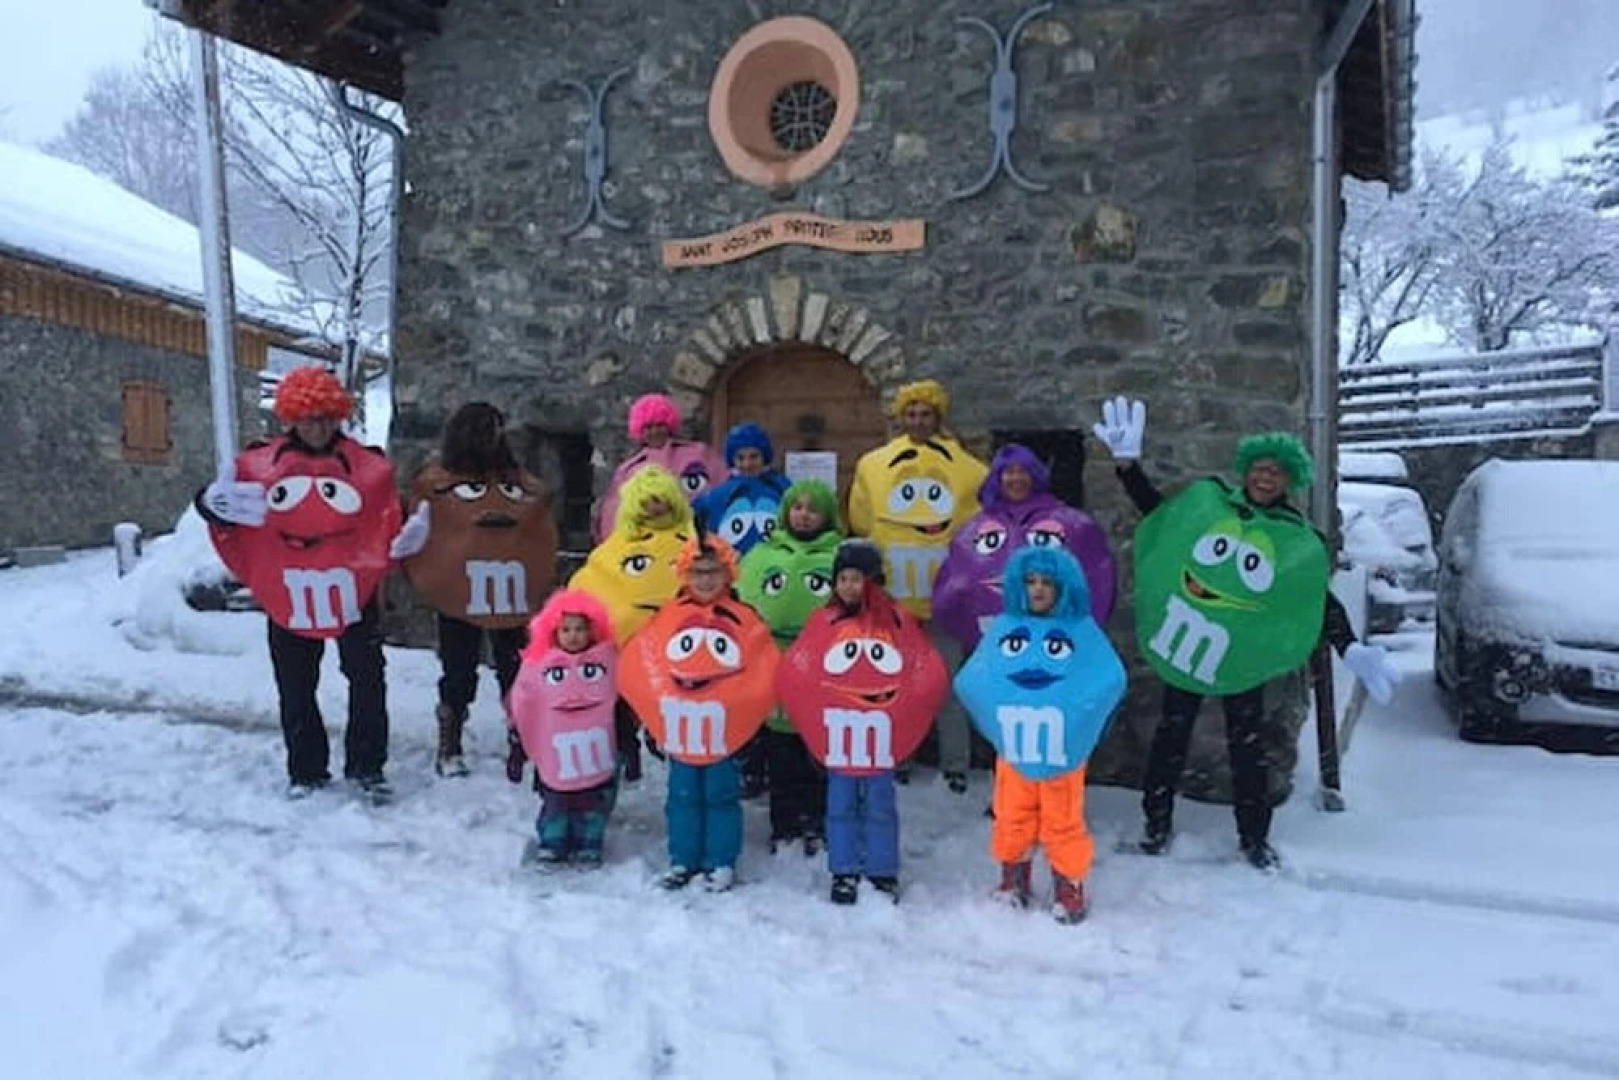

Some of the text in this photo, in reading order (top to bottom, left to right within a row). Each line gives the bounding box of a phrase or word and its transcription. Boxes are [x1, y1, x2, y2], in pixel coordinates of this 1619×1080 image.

[283, 566, 363, 629] m
[465, 560, 528, 616] m
[887, 543, 950, 598] m
[1148, 594, 1231, 685] m
[551, 727, 613, 780] m
[659, 695, 728, 756] m
[823, 707, 895, 769] m
[995, 704, 1068, 766] m
